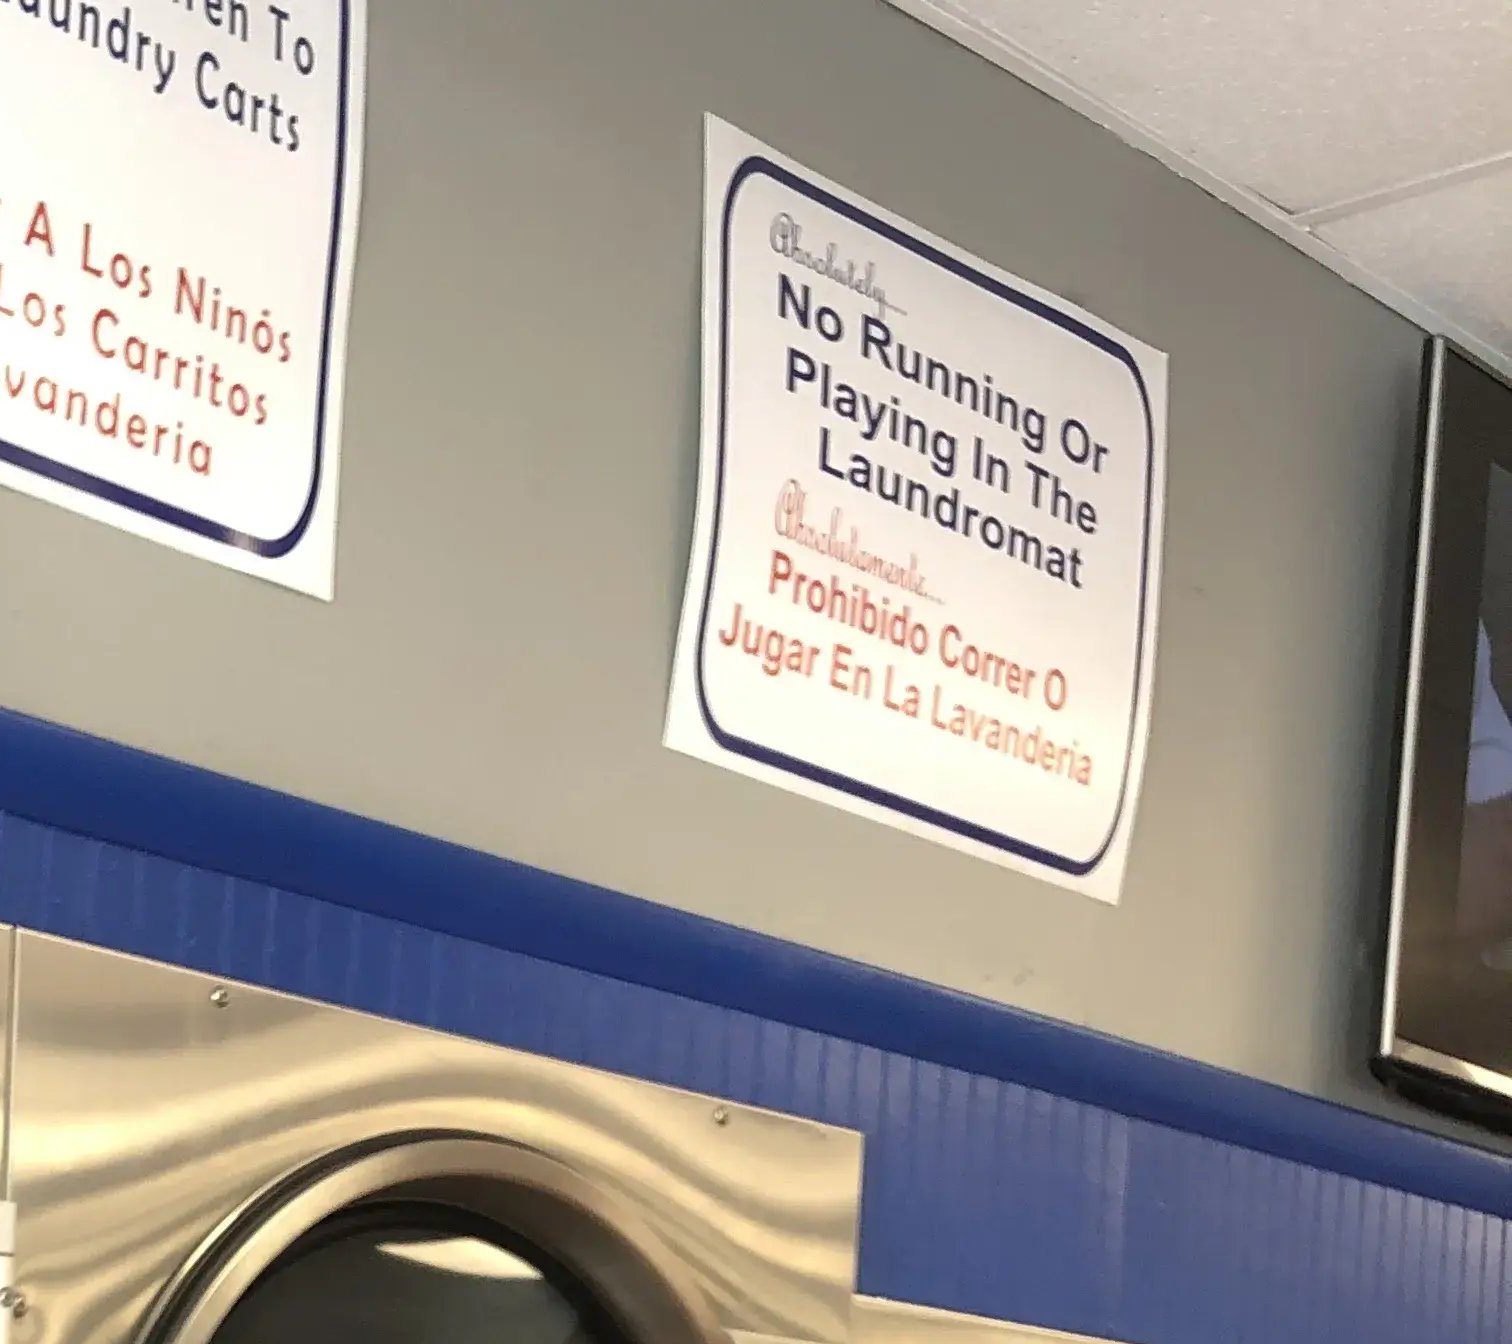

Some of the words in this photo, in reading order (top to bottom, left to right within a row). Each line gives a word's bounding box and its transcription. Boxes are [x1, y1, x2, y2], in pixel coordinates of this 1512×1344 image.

[195, 52, 300, 152] Carts
[269, 5, 315, 75] To
[24, 201, 55, 257] A
[82, 223, 152, 298] Los
[92, 308, 267, 425] Carritos
[778, 272, 843, 342] No
[861, 313, 1047, 453] Running
[1060, 418, 1109, 474] Or
[786, 346, 958, 478] Playing
[972, 435, 1010, 494] In
[1025, 460, 1097, 535] The
[818, 428, 1083, 590] Laundromat
[719, 603, 820, 677] Jugar
[829, 643, 872, 699] En
[883, 664, 920, 718] La
[930, 685, 1092, 787] Lavanderia
[768, 549, 928, 656] Prohibido
[938, 623, 1036, 700] Correr
[1043, 667, 1068, 711] O
